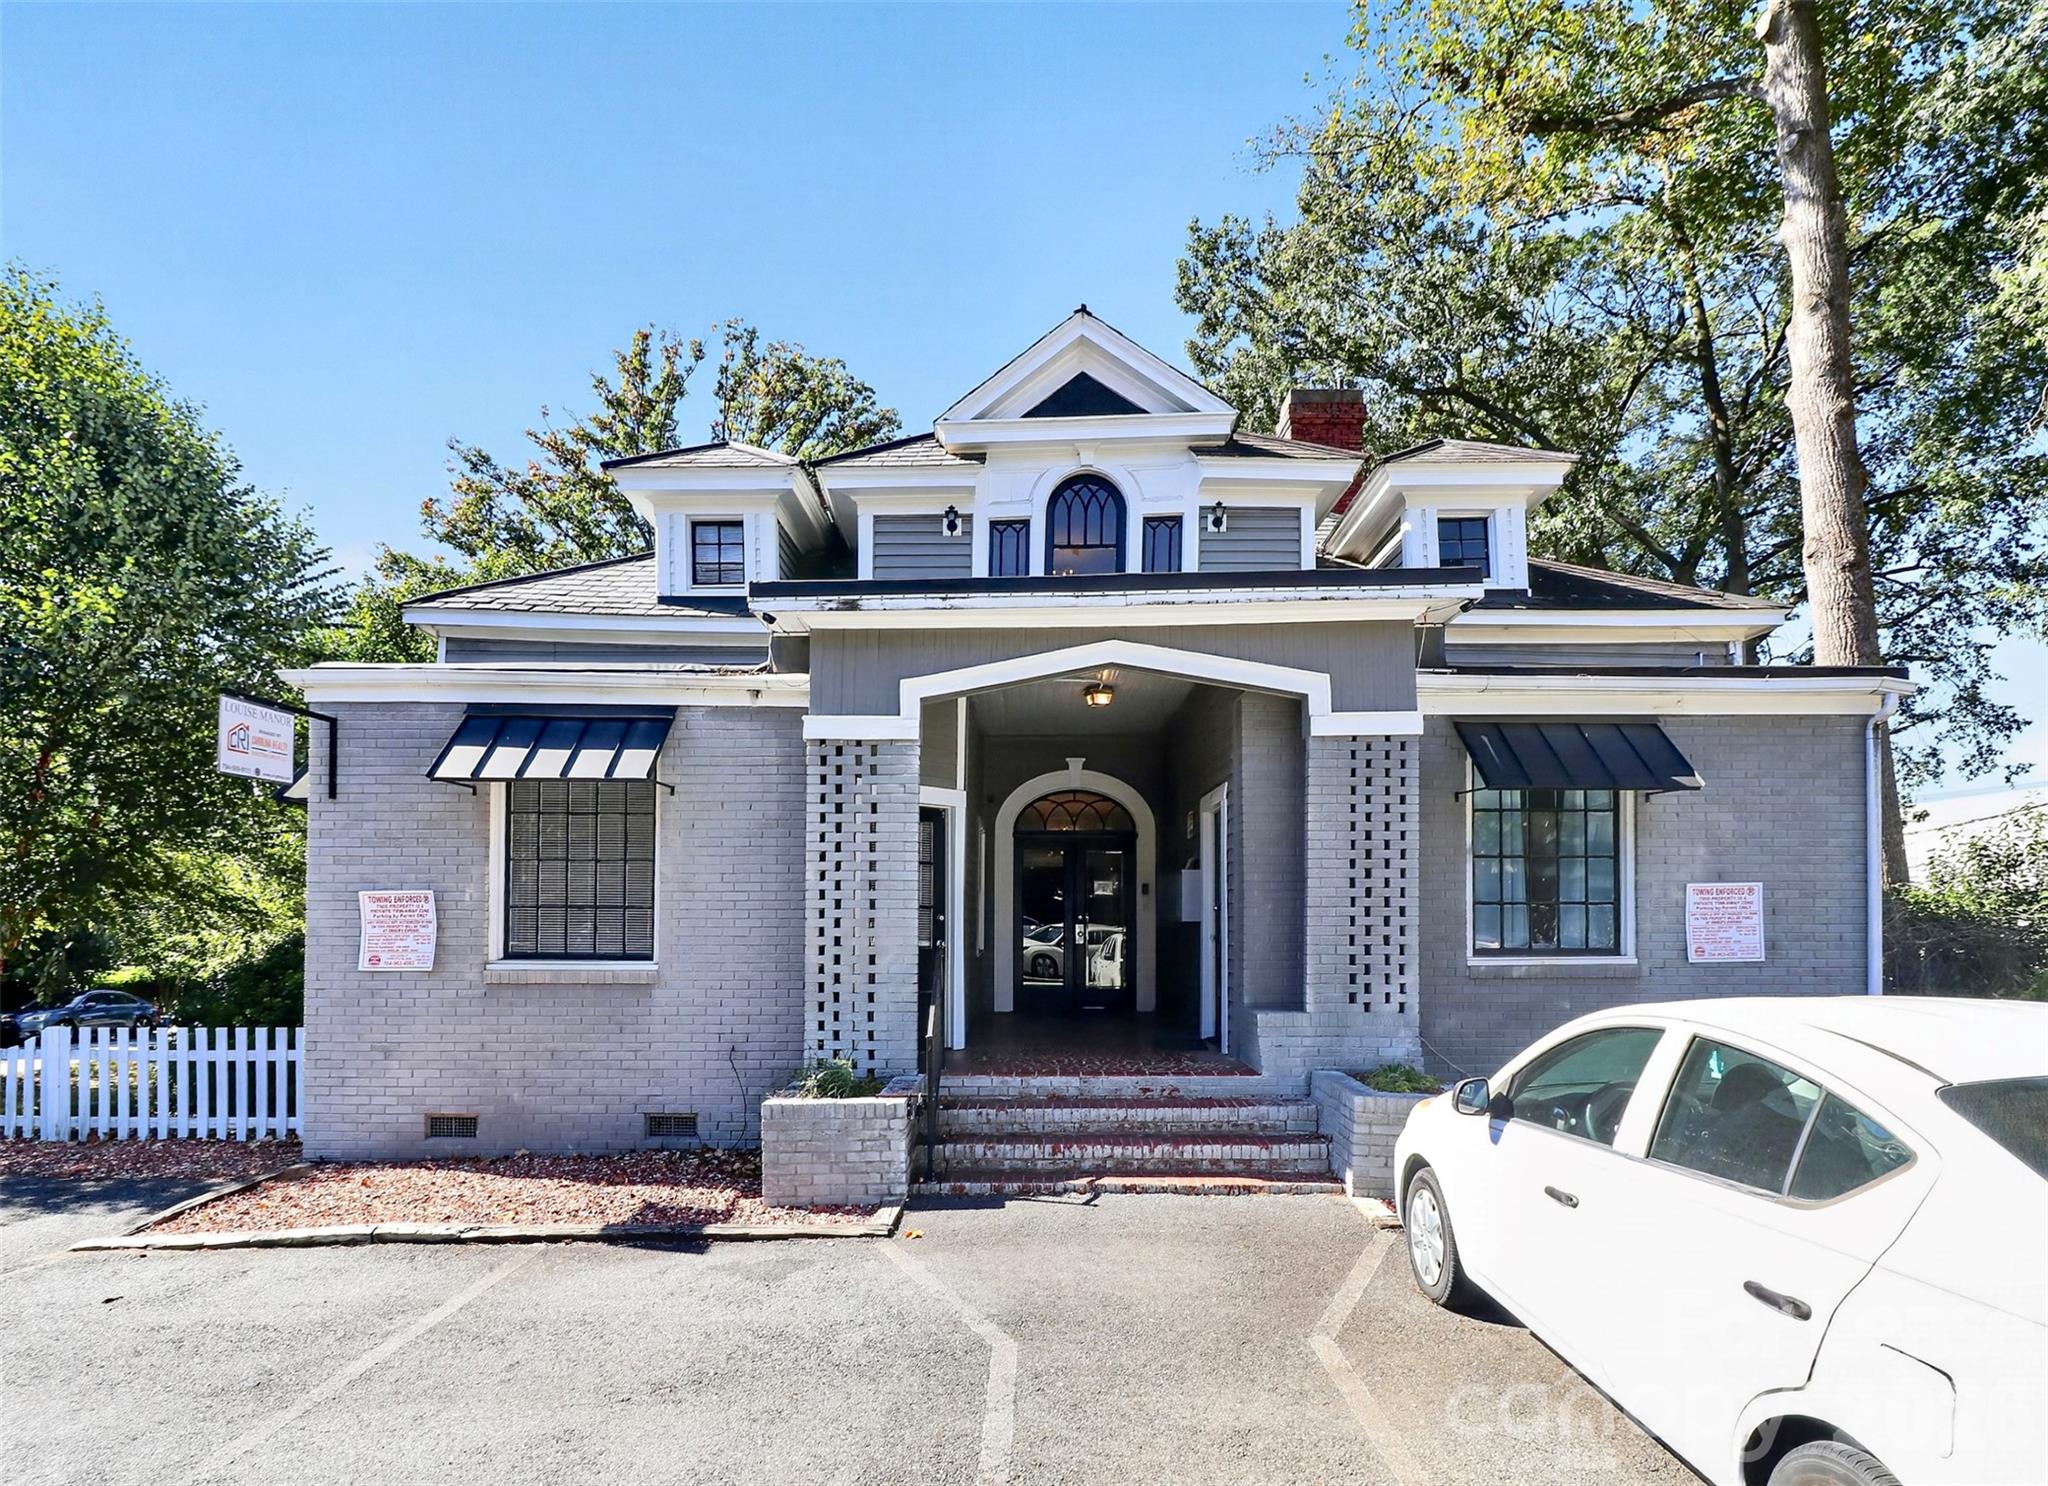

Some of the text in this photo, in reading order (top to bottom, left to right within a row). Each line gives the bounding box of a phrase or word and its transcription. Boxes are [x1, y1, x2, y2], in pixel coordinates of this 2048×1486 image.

[225, 702, 291, 726] LOUISE MANOR
[1692, 888, 1714, 896] TOWING
